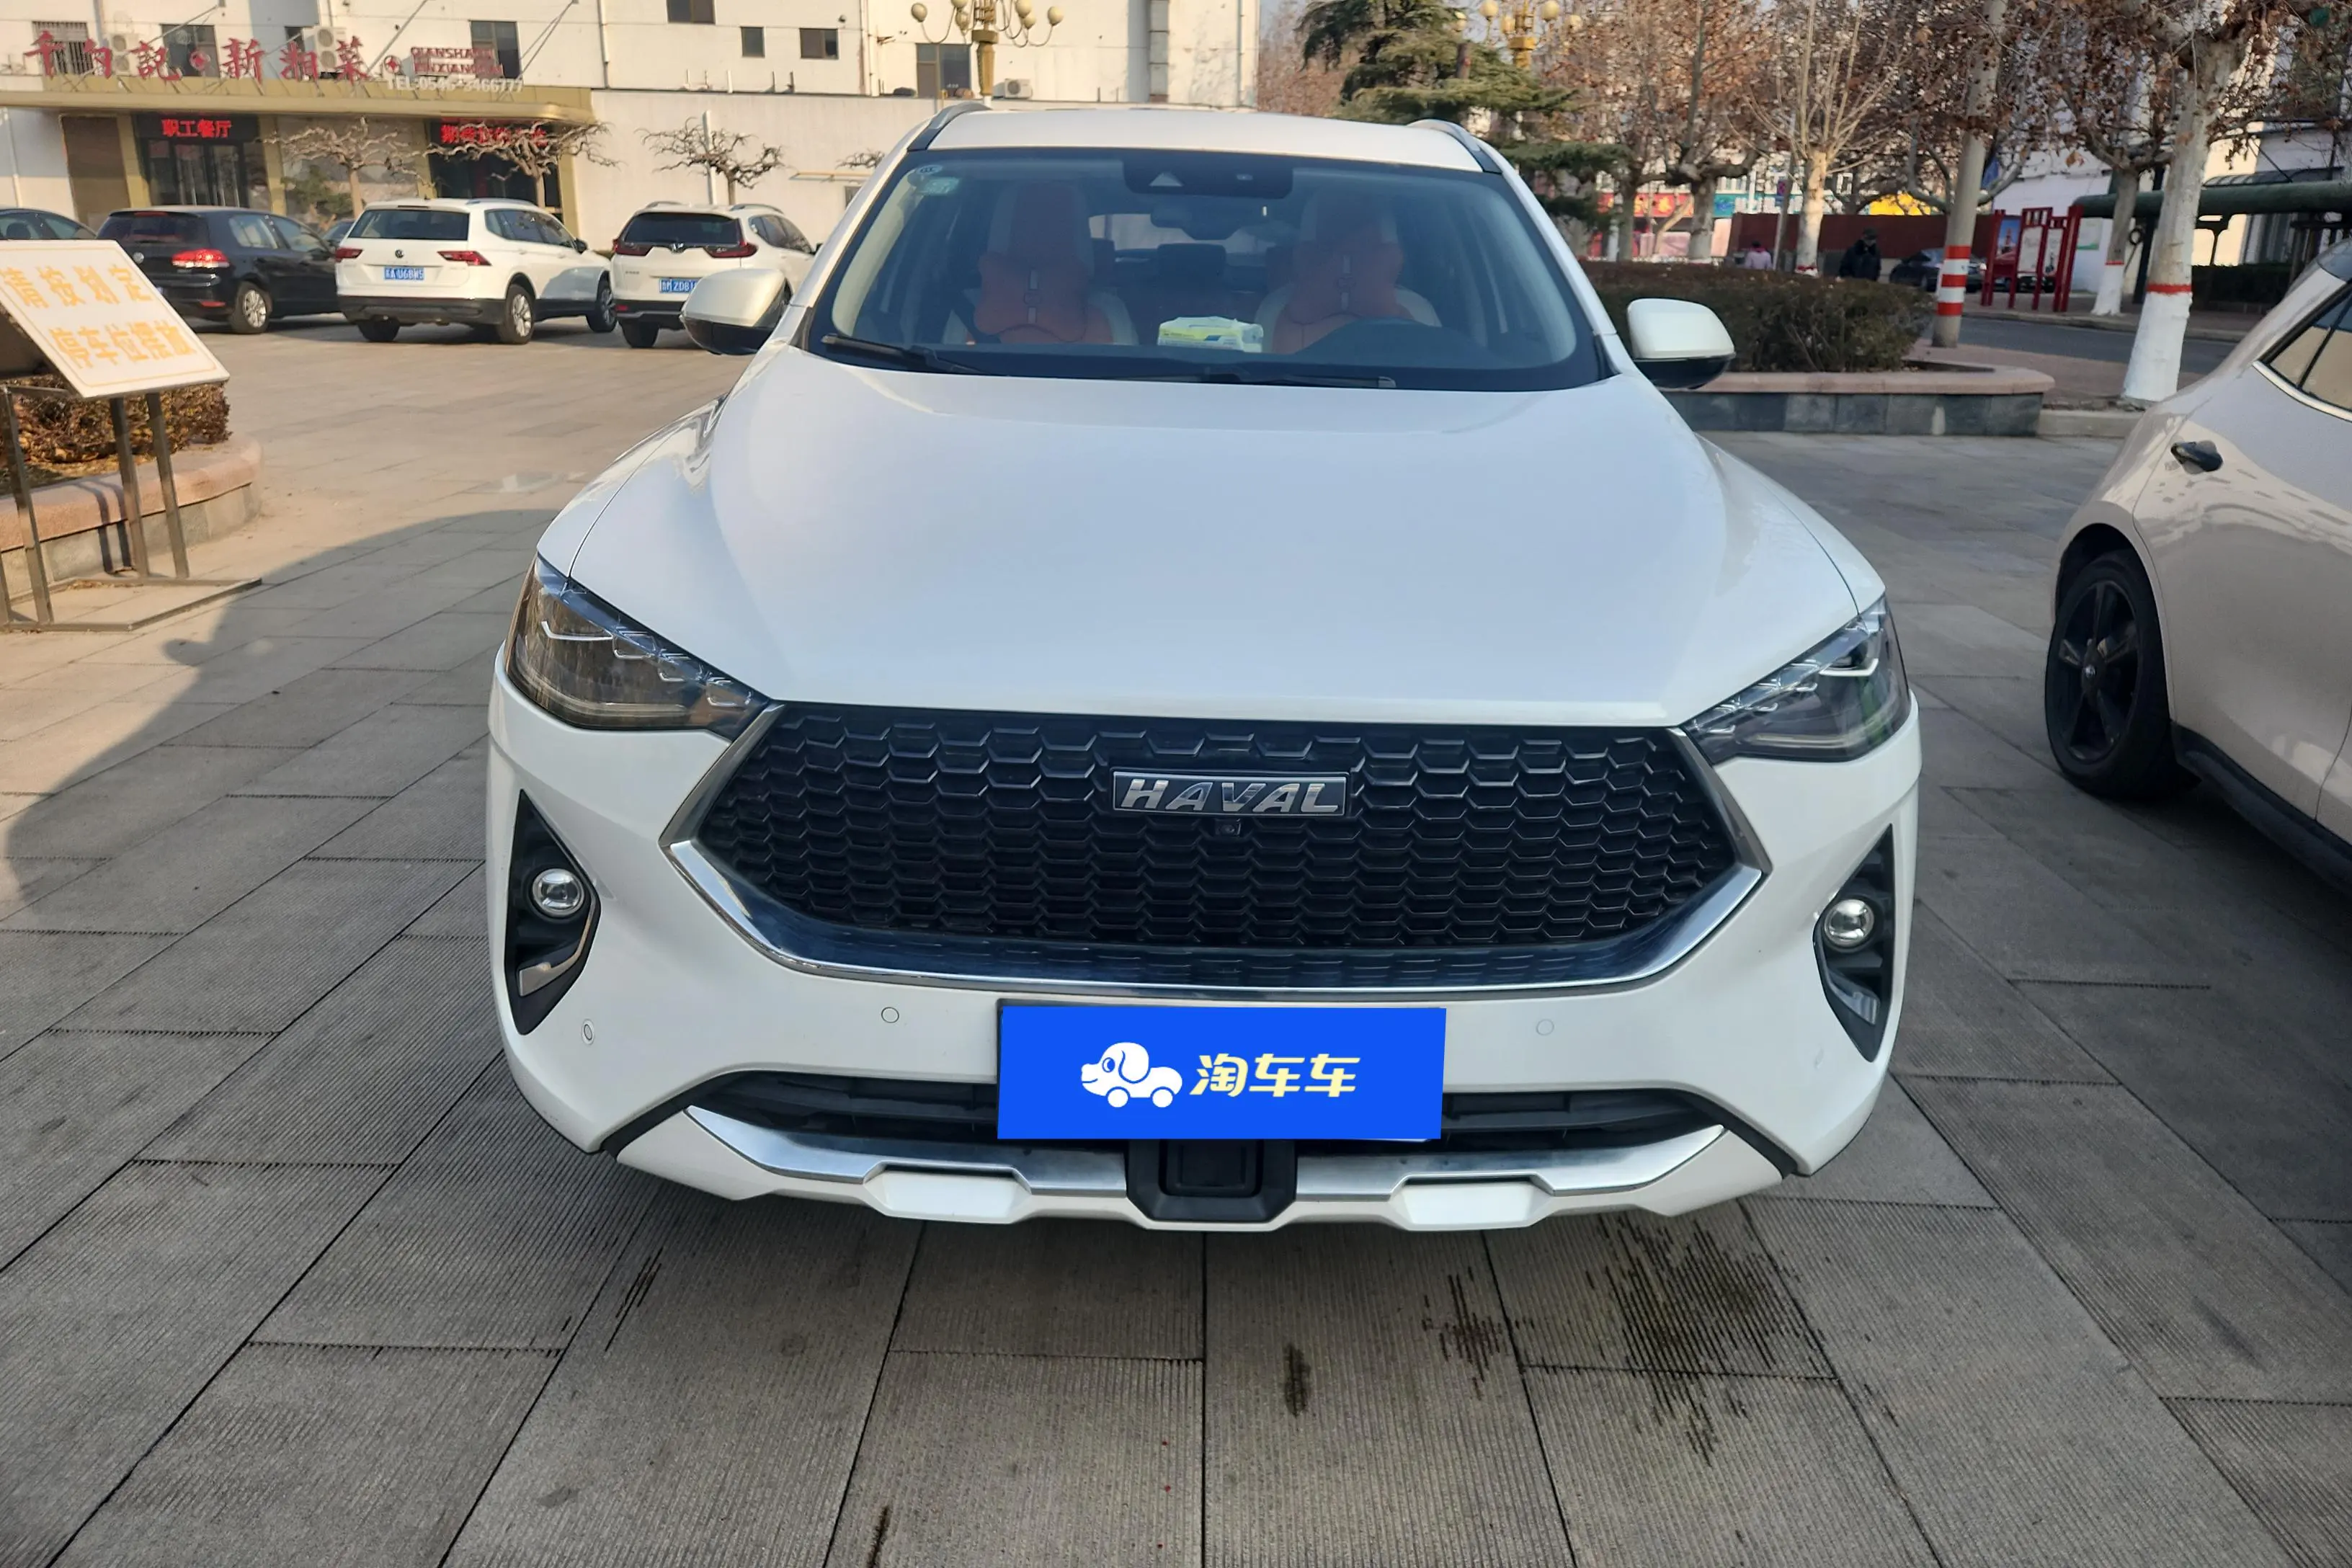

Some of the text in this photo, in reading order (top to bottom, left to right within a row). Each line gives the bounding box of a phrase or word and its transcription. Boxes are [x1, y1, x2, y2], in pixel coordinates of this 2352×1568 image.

[161, 118, 231, 138] 职工餐厅
[1, 264, 153, 308] 请按划定
[48, 320, 197, 369] 停车位摆放
[1121, 779, 1338, 812] HAVAL
